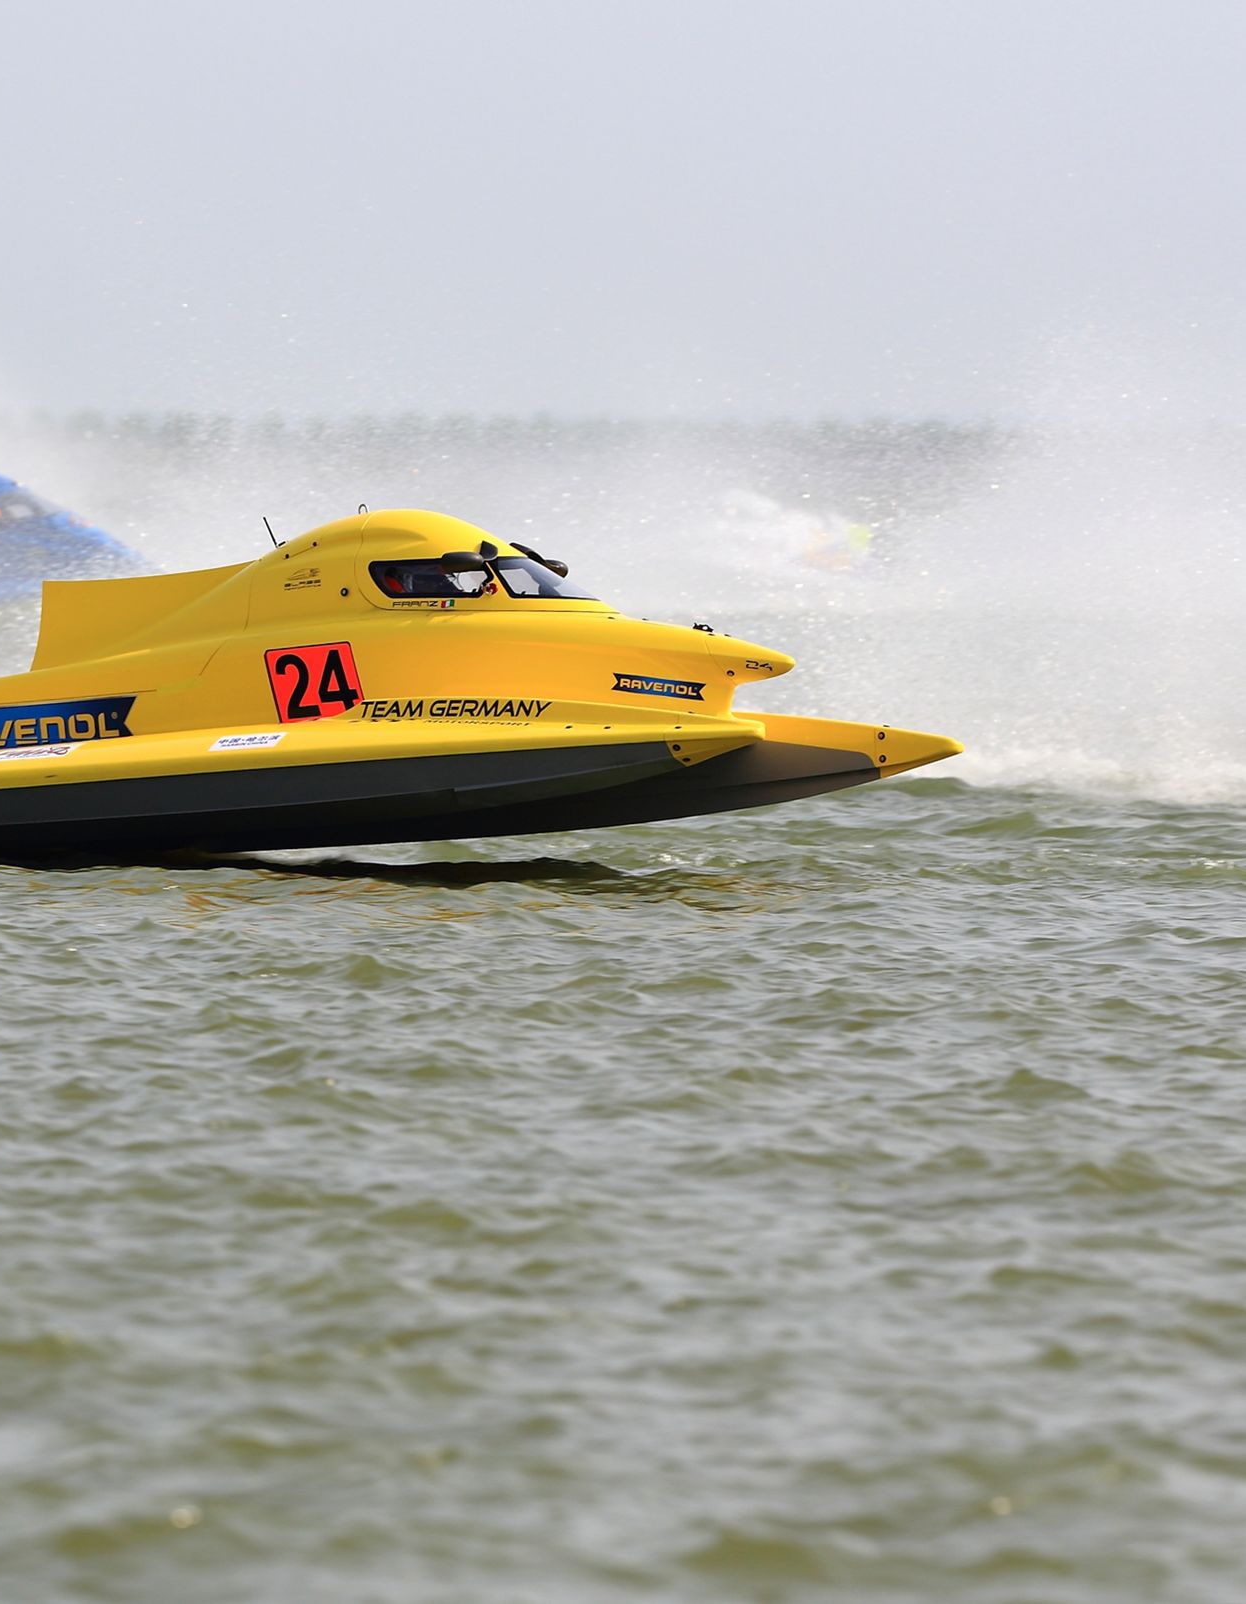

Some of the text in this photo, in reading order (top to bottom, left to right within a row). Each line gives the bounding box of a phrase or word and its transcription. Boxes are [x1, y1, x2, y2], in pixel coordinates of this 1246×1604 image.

[392, 600, 438, 608] FRANZ
[745, 660, 774, 672] 24
[275, 649, 358, 719] 24
[619, 678, 698, 697] RAVENOL
[361, 699, 553, 718] TEAM GERMANY
